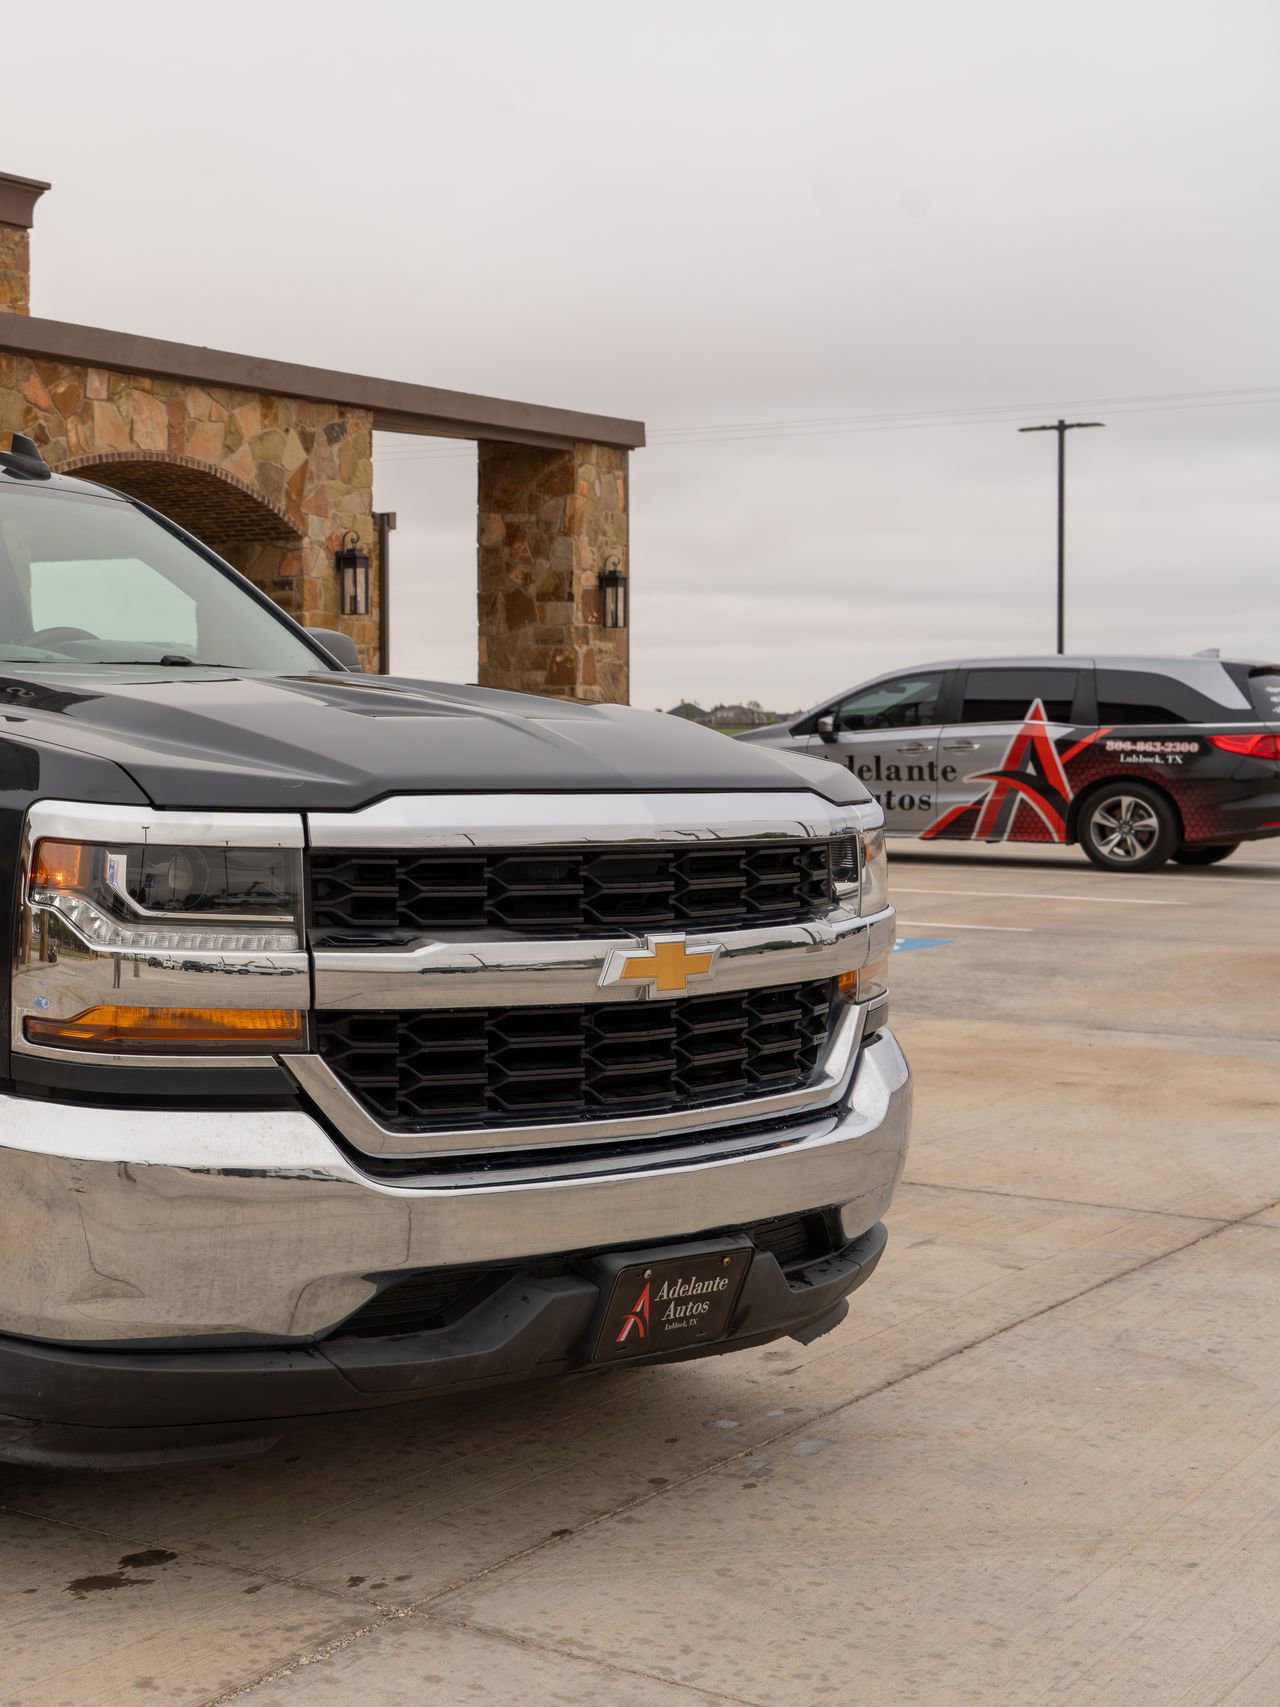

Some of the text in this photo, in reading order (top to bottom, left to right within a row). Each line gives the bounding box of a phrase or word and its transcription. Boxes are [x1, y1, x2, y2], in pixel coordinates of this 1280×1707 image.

[824, 755, 958, 783] delante
[1166, 754, 1184, 764] TX
[874, 789, 932, 812] tos
[654, 1276, 729, 1302] Adelante
[661, 1300, 710, 1321] Autos
